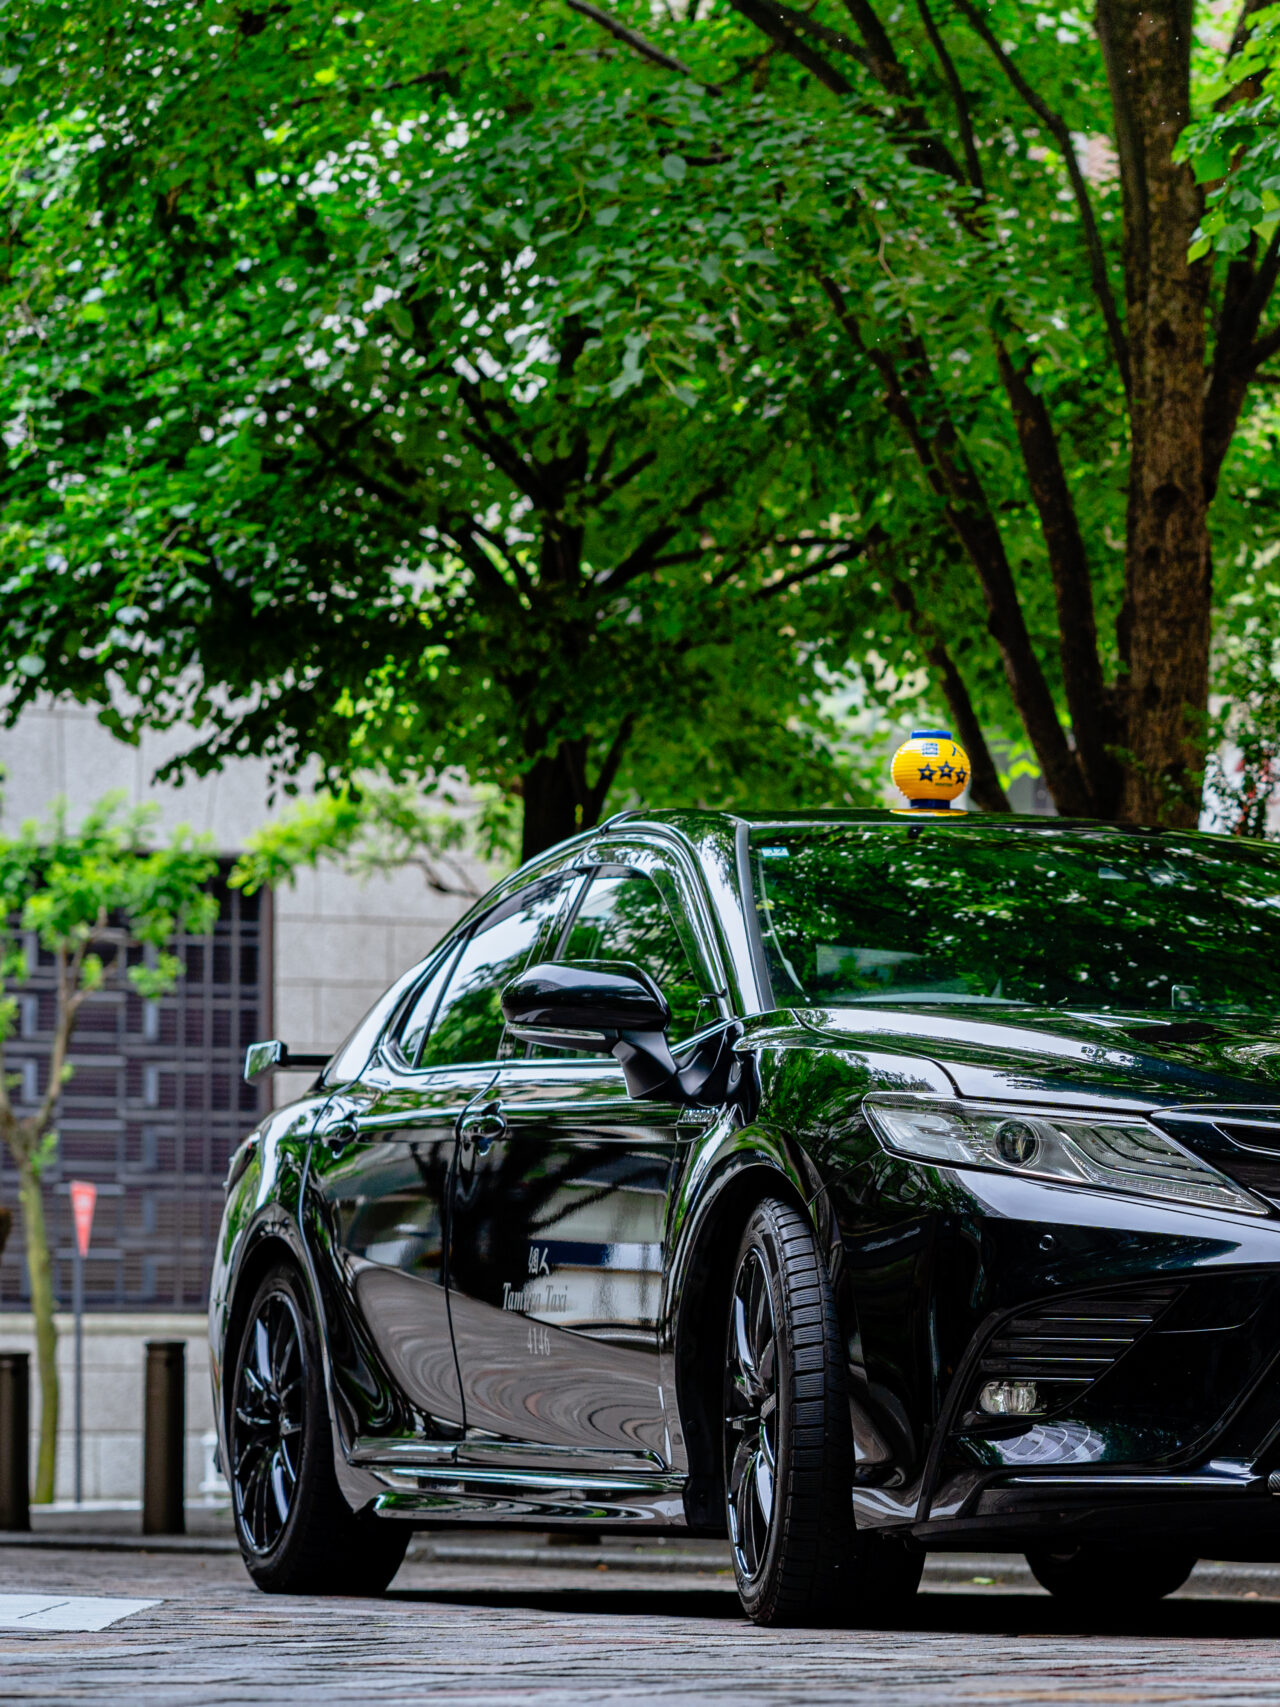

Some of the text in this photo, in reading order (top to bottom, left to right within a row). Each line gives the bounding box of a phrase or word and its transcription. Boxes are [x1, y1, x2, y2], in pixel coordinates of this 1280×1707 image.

[528, 1246, 550, 1275] 個人
[545, 1284, 569, 1313] Taxi
[527, 1327, 551, 1356] 4146
